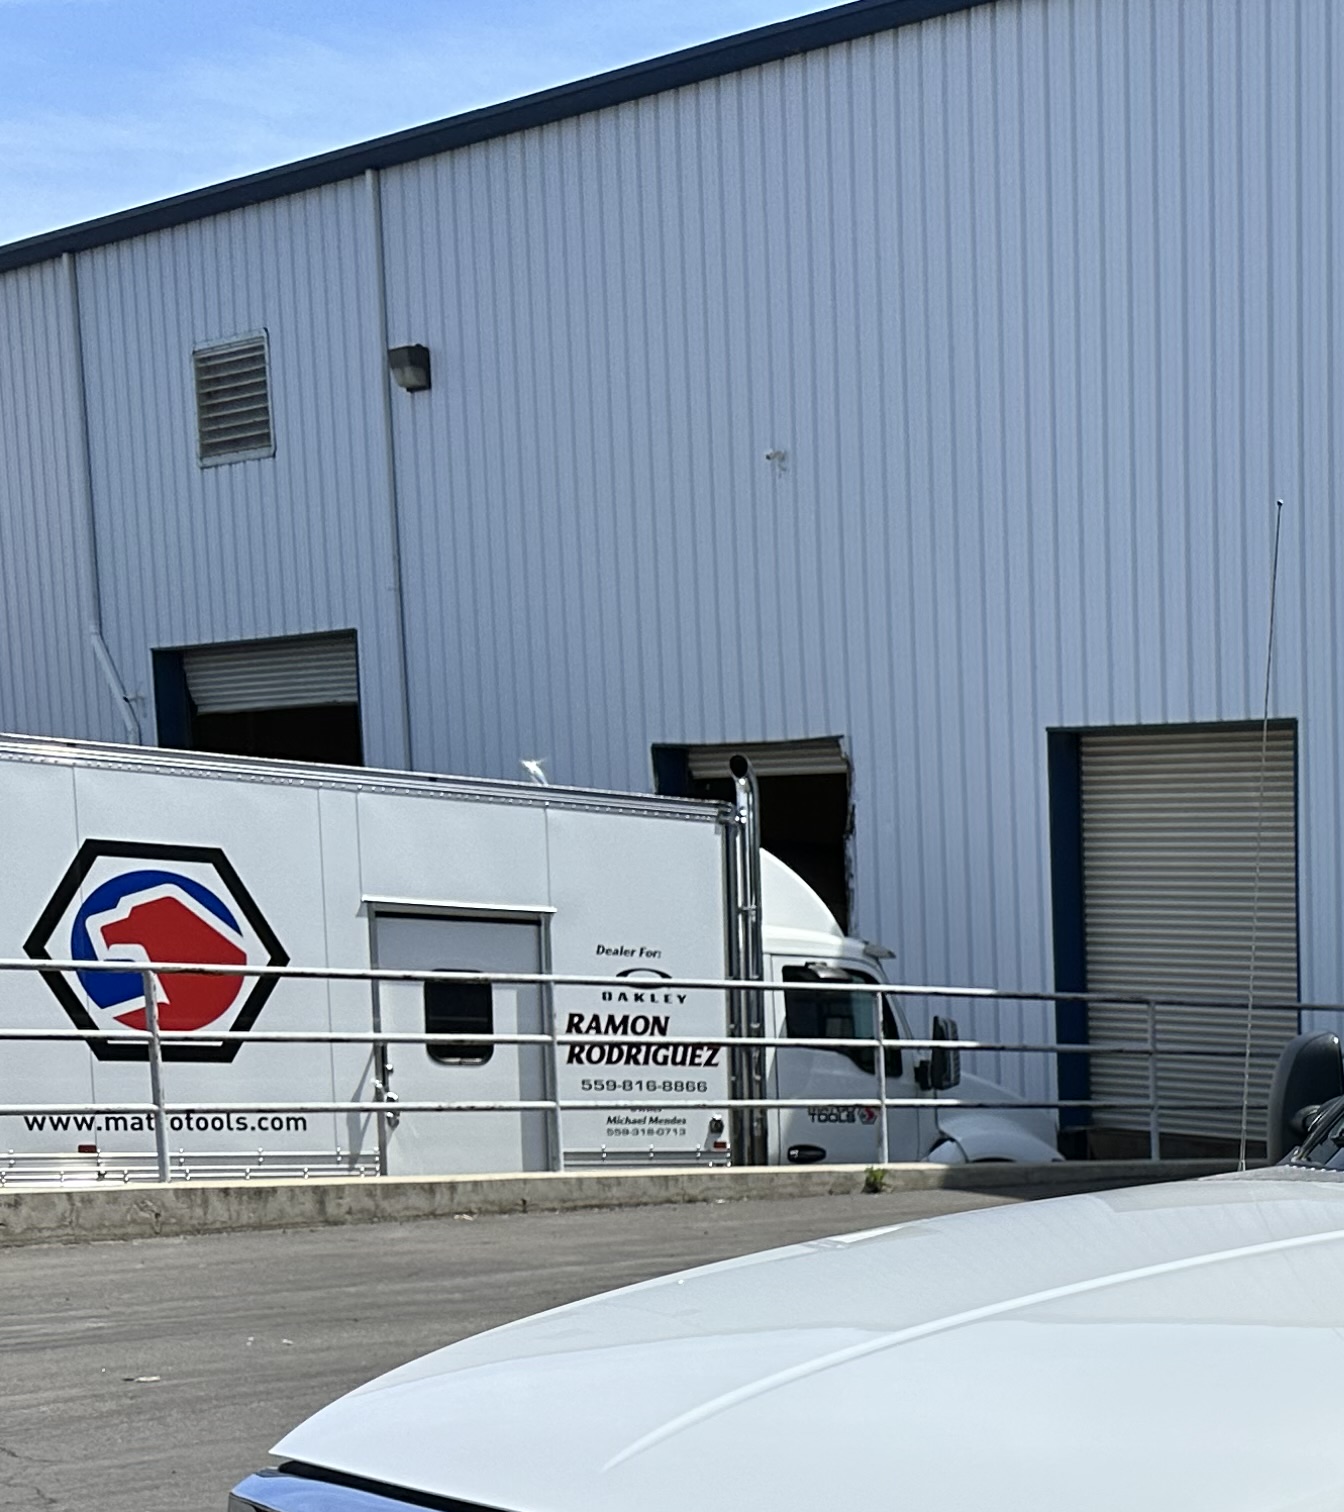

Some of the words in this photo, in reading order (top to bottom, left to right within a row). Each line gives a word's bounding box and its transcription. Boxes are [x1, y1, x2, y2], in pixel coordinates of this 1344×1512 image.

[596, 944, 635, 957] Dealer
[638, 947, 662, 959] For:
[601, 991, 687, 1004] OAKLEY
[566, 1013, 670, 1036] RAMON
[566, 1043, 721, 1067] RODRIGUEZ
[581, 1079, 708, 1093] 559-816-8866
[23, 1112, 308, 1131] www.matotools.com
[606, 1116, 647, 1125] Michael
[809, 1113, 856, 1124] TOOLS
